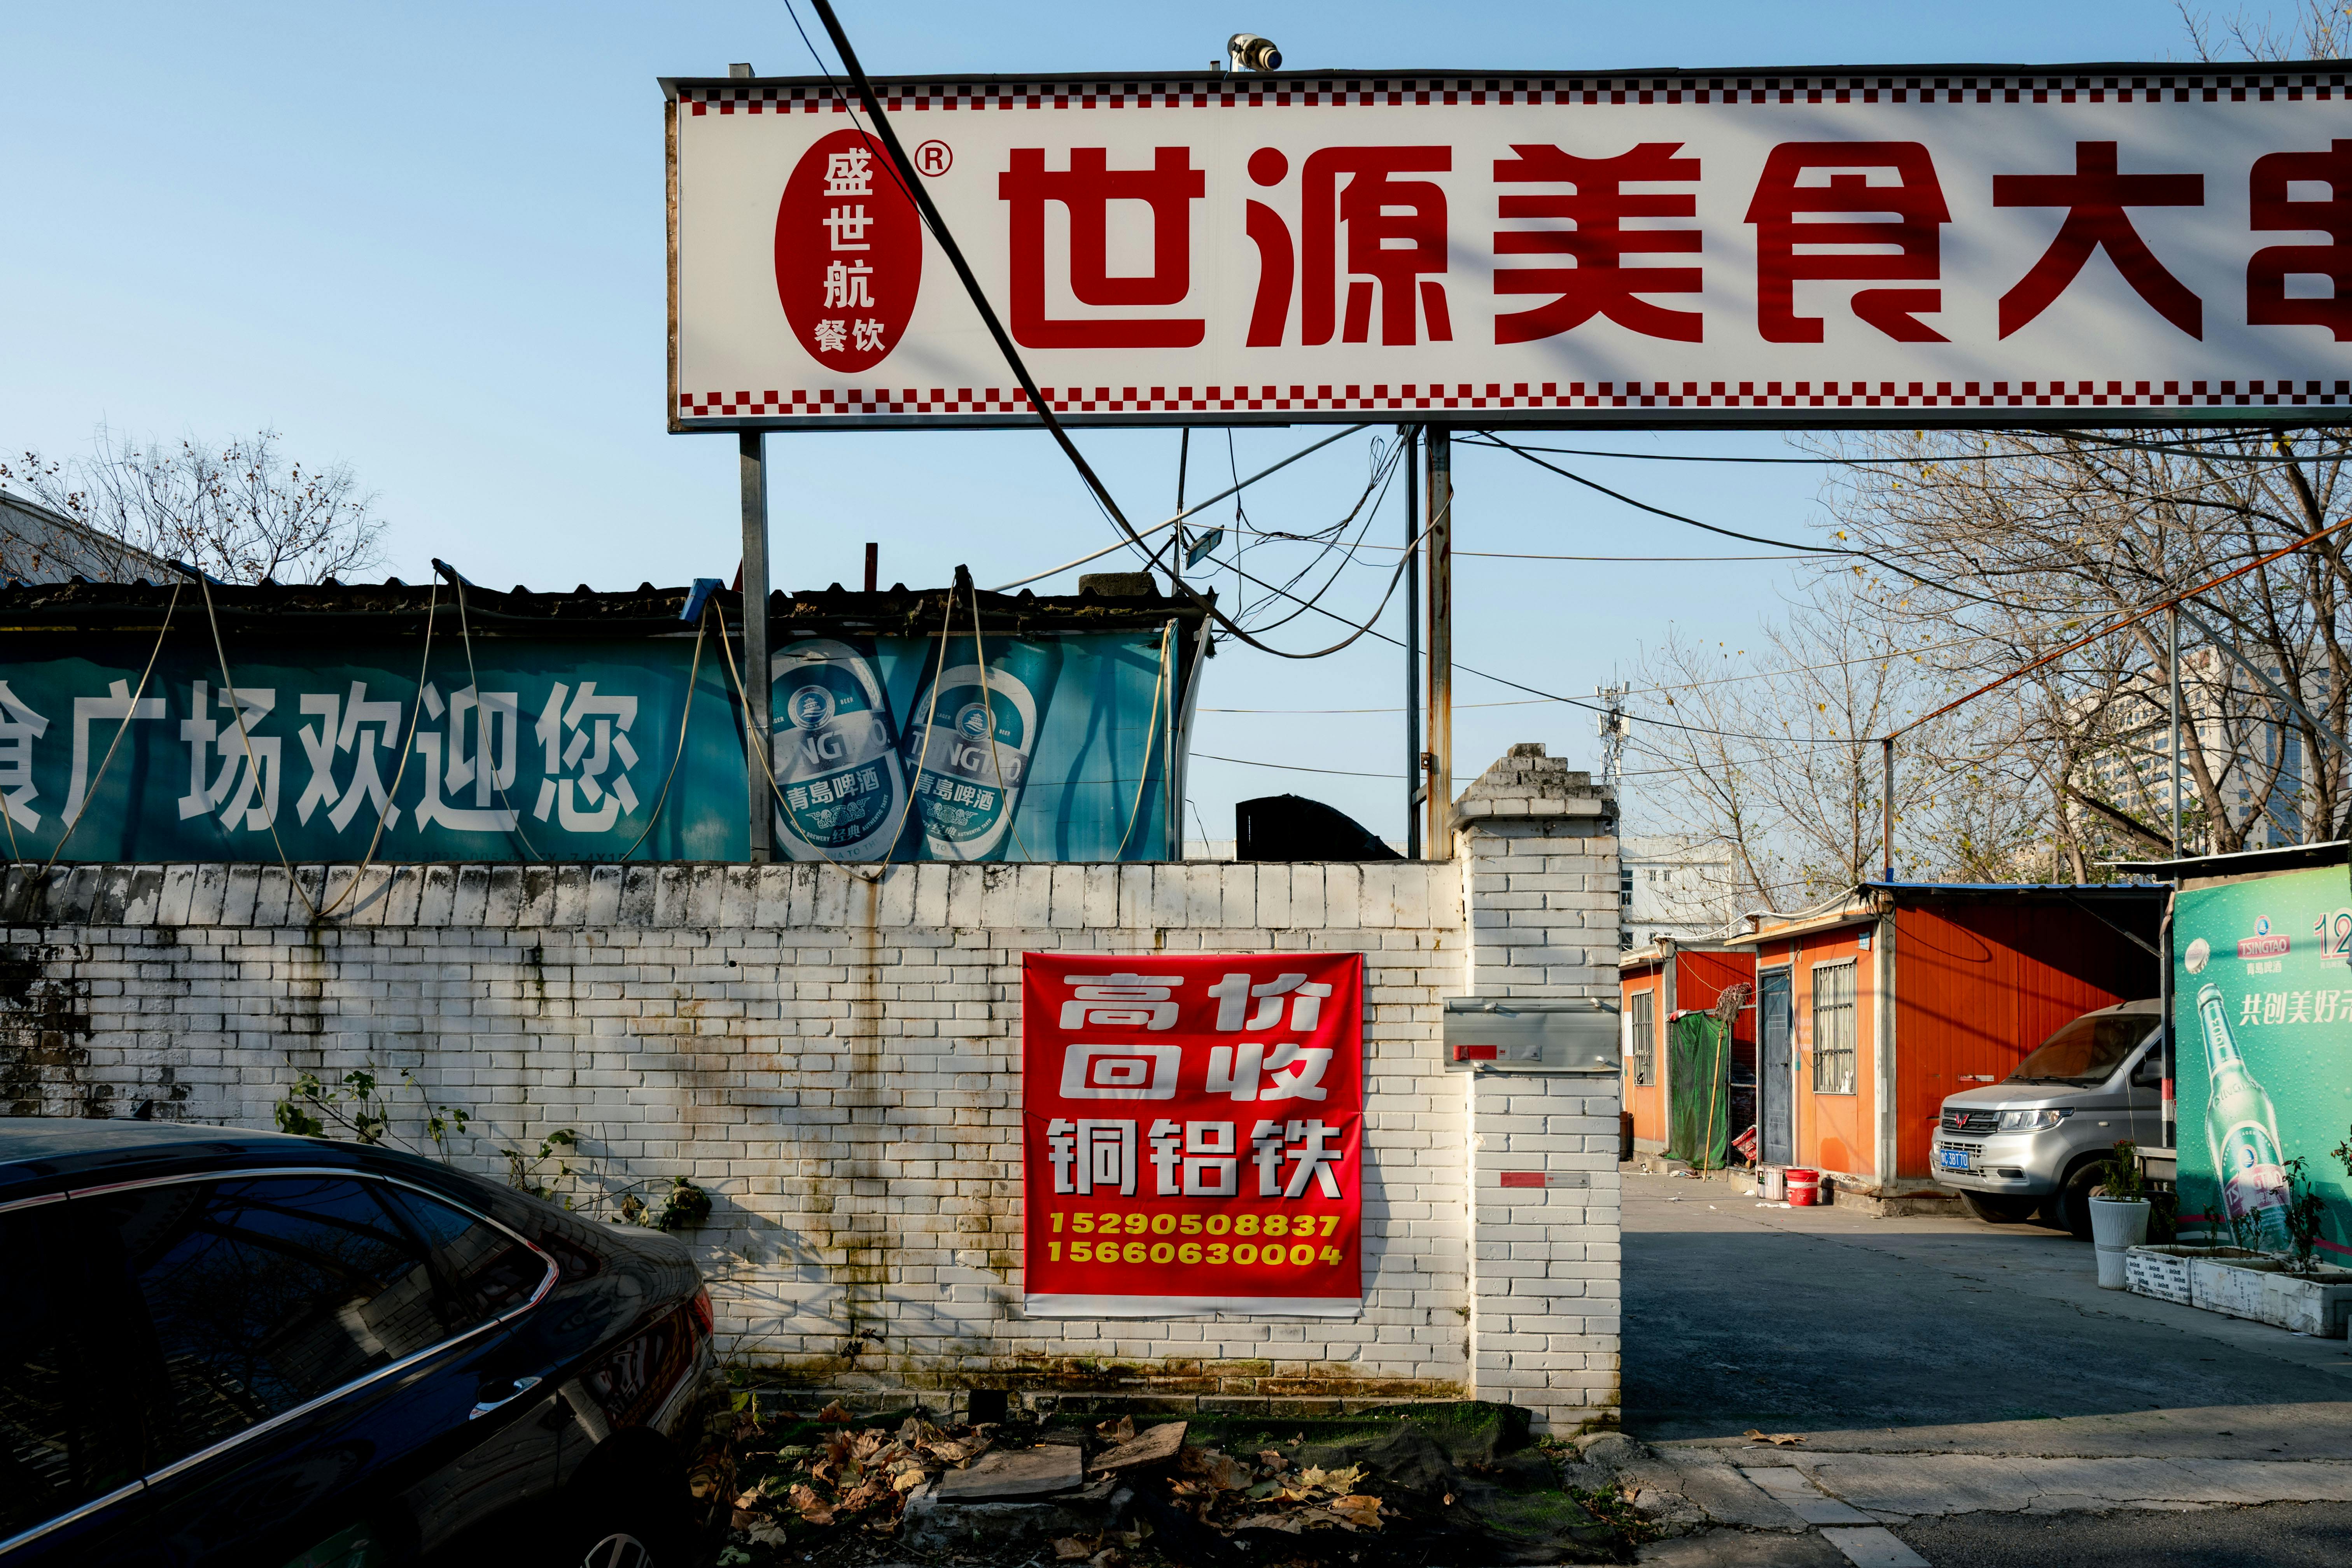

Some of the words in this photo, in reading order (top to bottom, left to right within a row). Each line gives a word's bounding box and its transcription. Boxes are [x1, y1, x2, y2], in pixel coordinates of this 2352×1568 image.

[823, 147, 875, 309] 盛世航
[814, 318, 885, 352] 餐饮
[840, 696, 854, 705] BEER
[936, 712, 951, 720] LAGER
[786, 766, 880, 812] 青島啤酒
[915, 773, 996, 811] 青島啤酒
[862, 808, 884, 831] AUTHENTIC
[880, 794, 889, 809] TASTE
[806, 831, 830, 842] BREWERY
[832, 824, 861, 843] 经典
[930, 822, 957, 839] 经典
[957, 827, 982, 837] AUTHENTIC
[981, 817, 993, 830] TASTE
[847, 848, 860, 857] TO
[936, 843, 947, 851] TO
[2240, 939, 2287, 955] TSINGTAO
[1059, 973, 1332, 1031] 高价
[1059, 1043, 1333, 1101] 回收
[1046, 1118, 1342, 1199] 铜铝铁
[1050, 1212, 1340, 1237] 15290508837
[1048, 1241, 1343, 1265] 15660630004
